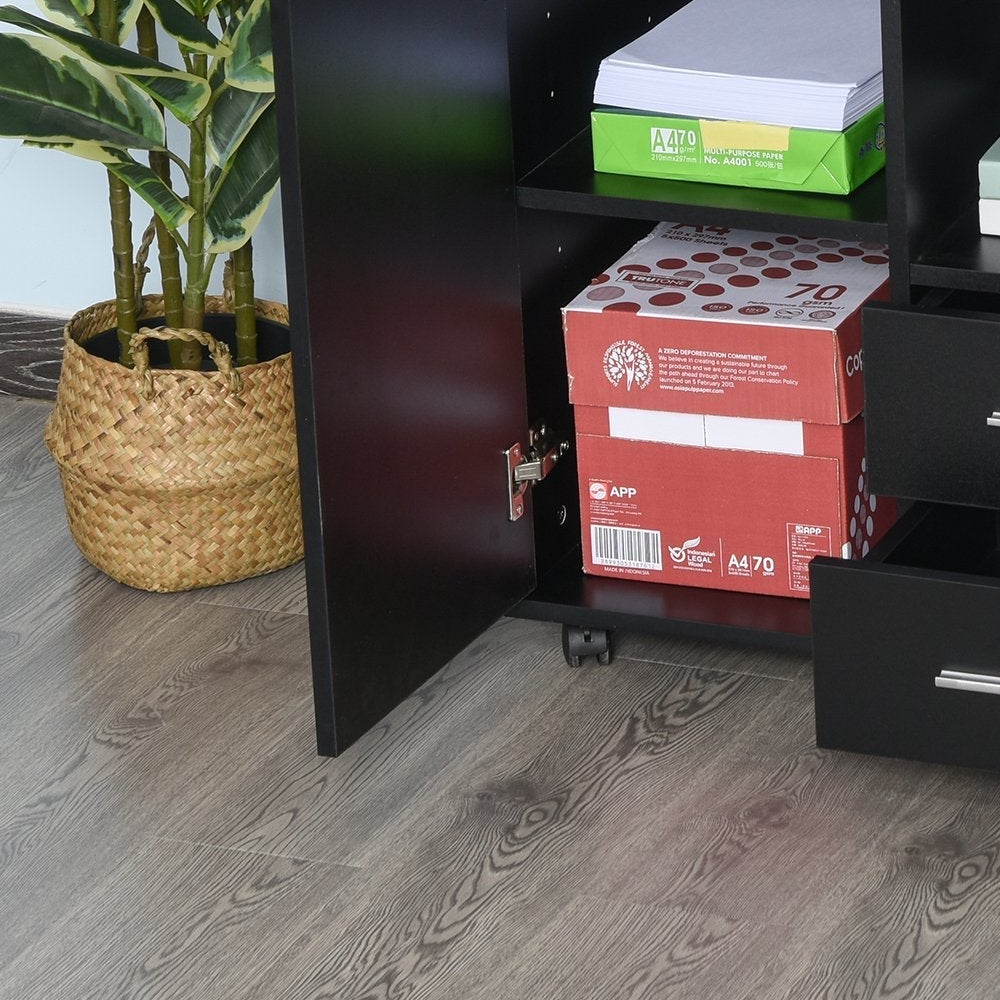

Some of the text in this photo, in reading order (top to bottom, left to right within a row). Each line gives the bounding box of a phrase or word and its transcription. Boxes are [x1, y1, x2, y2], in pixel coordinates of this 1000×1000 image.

[652, 128, 696, 153] A4 70
[651, 153, 697, 163] 210mmx297mm
[704, 148, 784, 161] MULTI-PURPOSE PAPER
[704, 155, 720, 165] No.
[723, 156, 752, 167] A4001
[784, 283, 848, 301] 70
[680, 349, 727, 359] DEFORESTATION
[727, 352, 768, 361] COMMITMENT
[668, 355, 688, 363] believe
[694, 358, 716, 366] creating
[721, 360, 750, 368] sustainable
[750, 361, 766, 369] future
[767, 363, 788, 371] through
[722, 367, 737, 375] doing
[697, 379, 720, 388] February
[699, 372, 719, 380] through
[730, 374, 746, 382] Forest
[747, 376, 782, 384] Conservation
[782, 378, 799, 387] Policy
[610, 486, 637, 498] APP
[803, 526, 822, 535] APP
[687, 549, 716, 557] Indonesian
[687, 556, 712, 564] LEGAL
[728, 554, 749, 569] A4
[752, 556, 774, 572] 70
[625, 568, 650, 576] INDONESIA
